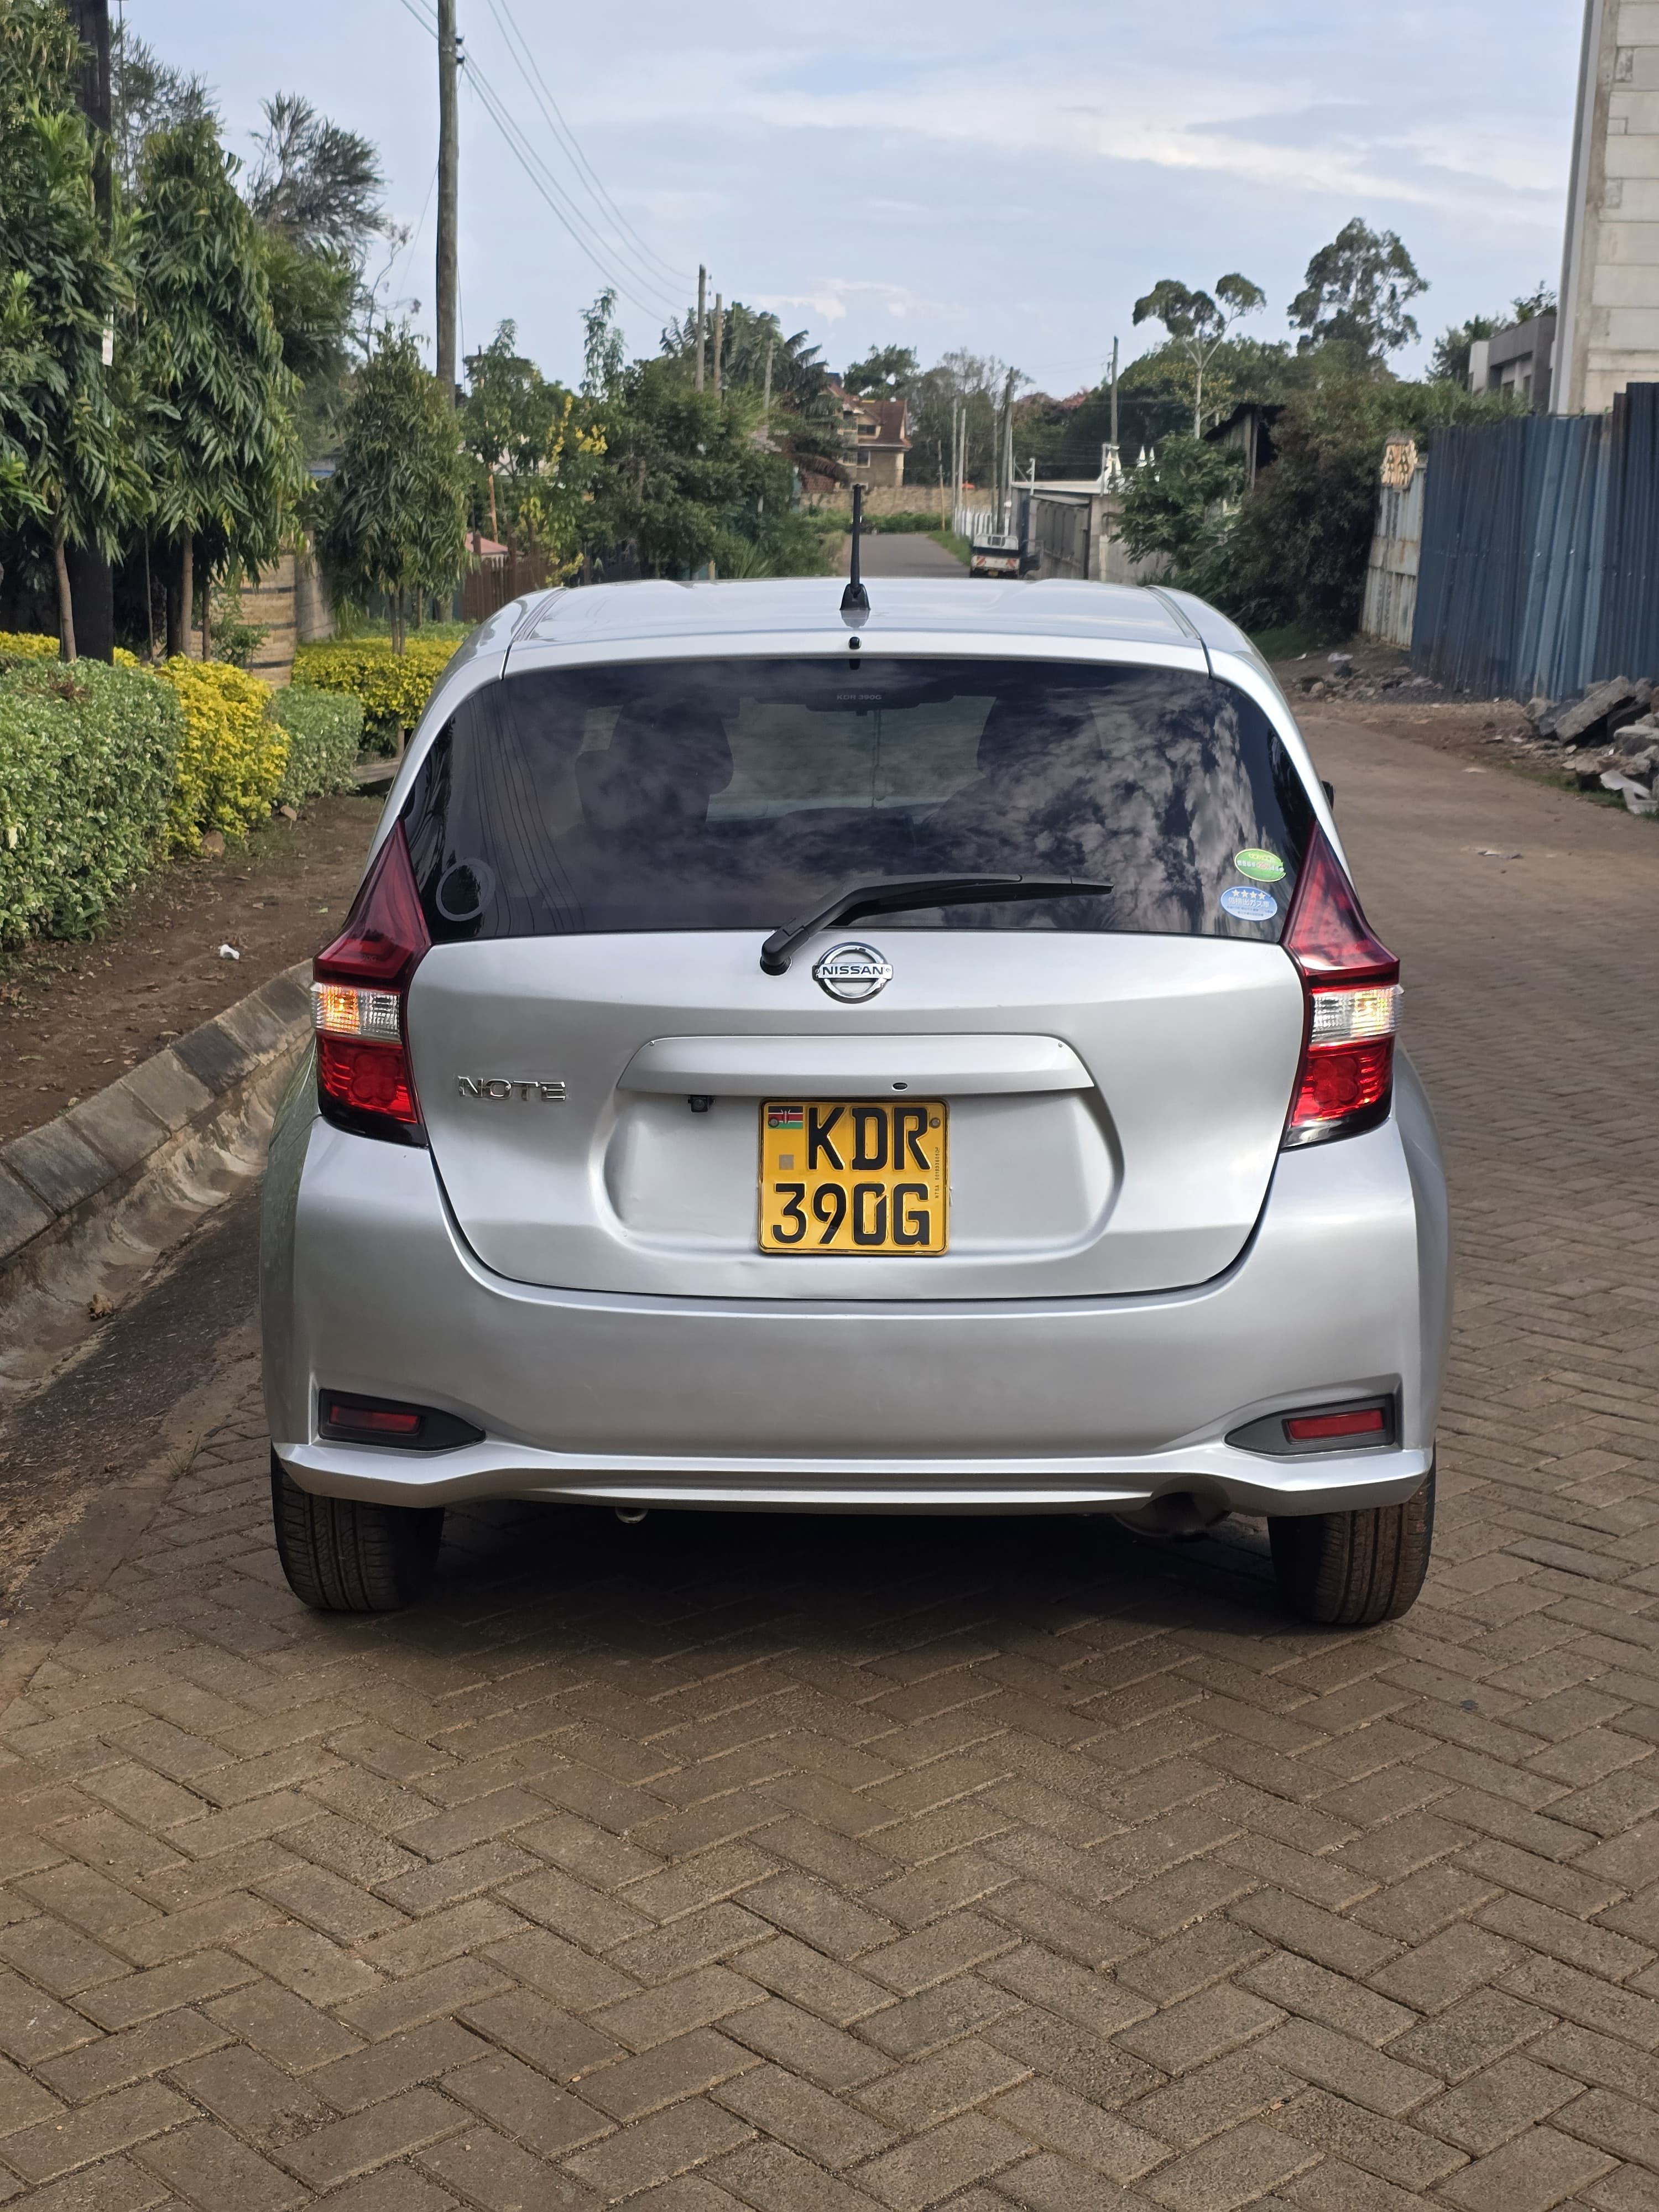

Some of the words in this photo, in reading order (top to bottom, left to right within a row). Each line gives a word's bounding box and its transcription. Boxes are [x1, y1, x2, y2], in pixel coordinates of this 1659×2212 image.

[822, 966, 884, 975] NISSAN
[458, 1075, 566, 1102] NOTE
[808, 1107, 932, 1171] KDR
[772, 1182, 930, 1245] 390G
